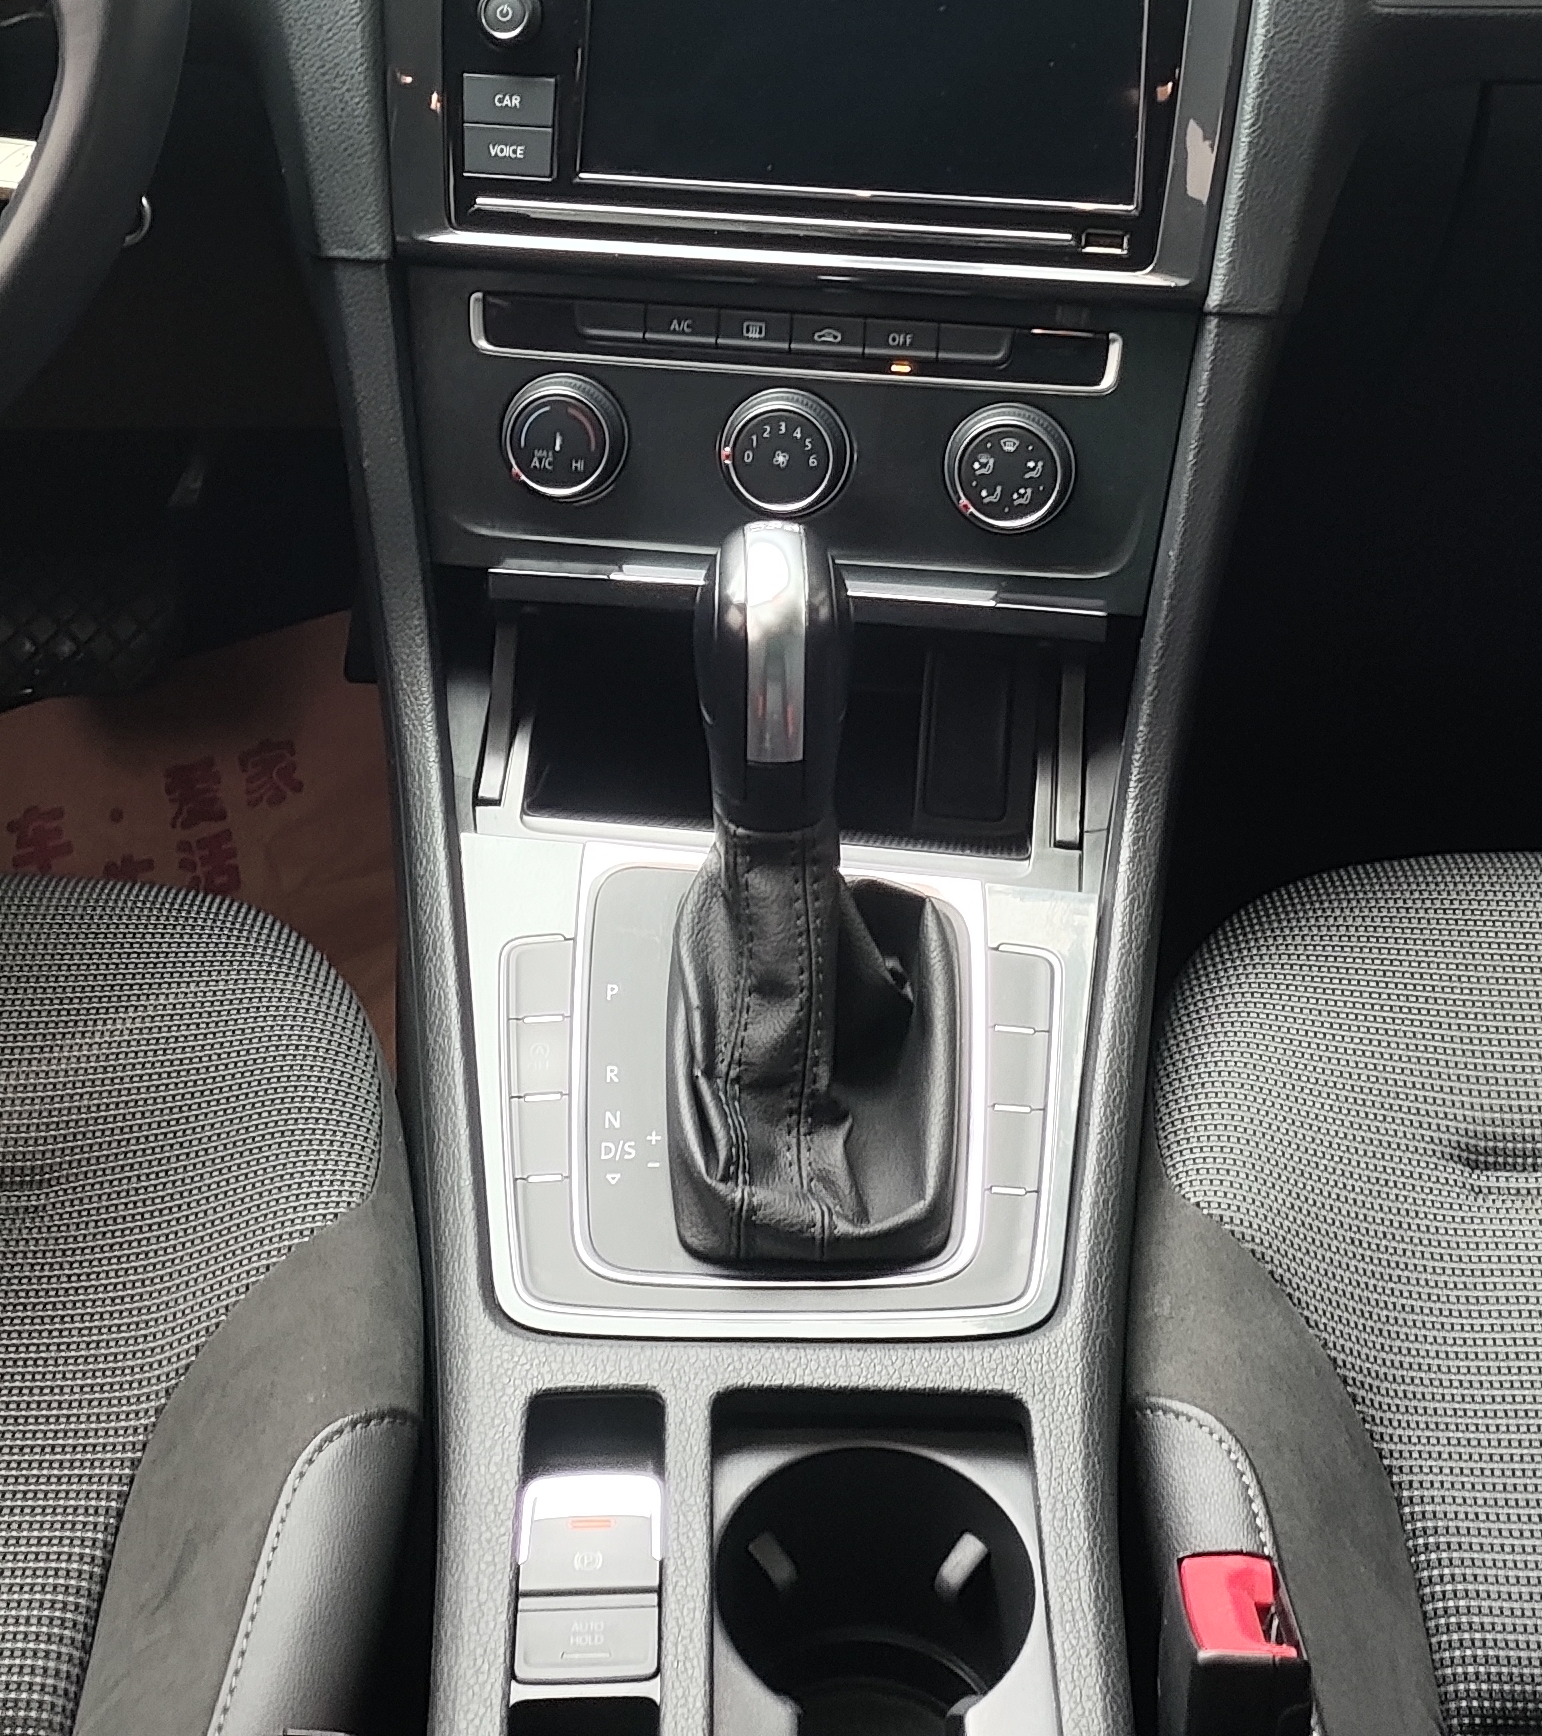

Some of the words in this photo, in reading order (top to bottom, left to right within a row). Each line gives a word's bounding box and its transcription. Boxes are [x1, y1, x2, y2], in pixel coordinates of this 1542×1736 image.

[494, 94, 521, 108] CAR
[489, 144, 525, 158] VOICE
[670, 319, 693, 333] A/C
[888, 332, 913, 347] OFF
[763, 425, 771, 438] 2
[779, 422, 786, 434] 3
[793, 426, 802, 440] 4
[751, 434, 758, 448] 1
[804, 438, 812, 451] 5
[744, 450, 753, 463] 0
[809, 454, 818, 467] 6
[530, 457, 554, 471] A/C
[571, 459, 585, 472] HI
[606, 983, 619, 1001] P
[606, 1065, 619, 1083] R
[604, 1111, 621, 1129] N
[600, 1140, 636, 1161] D/S
[571, 1621, 604, 1633] AUTO
[570, 1634, 604, 1646] HOLD
